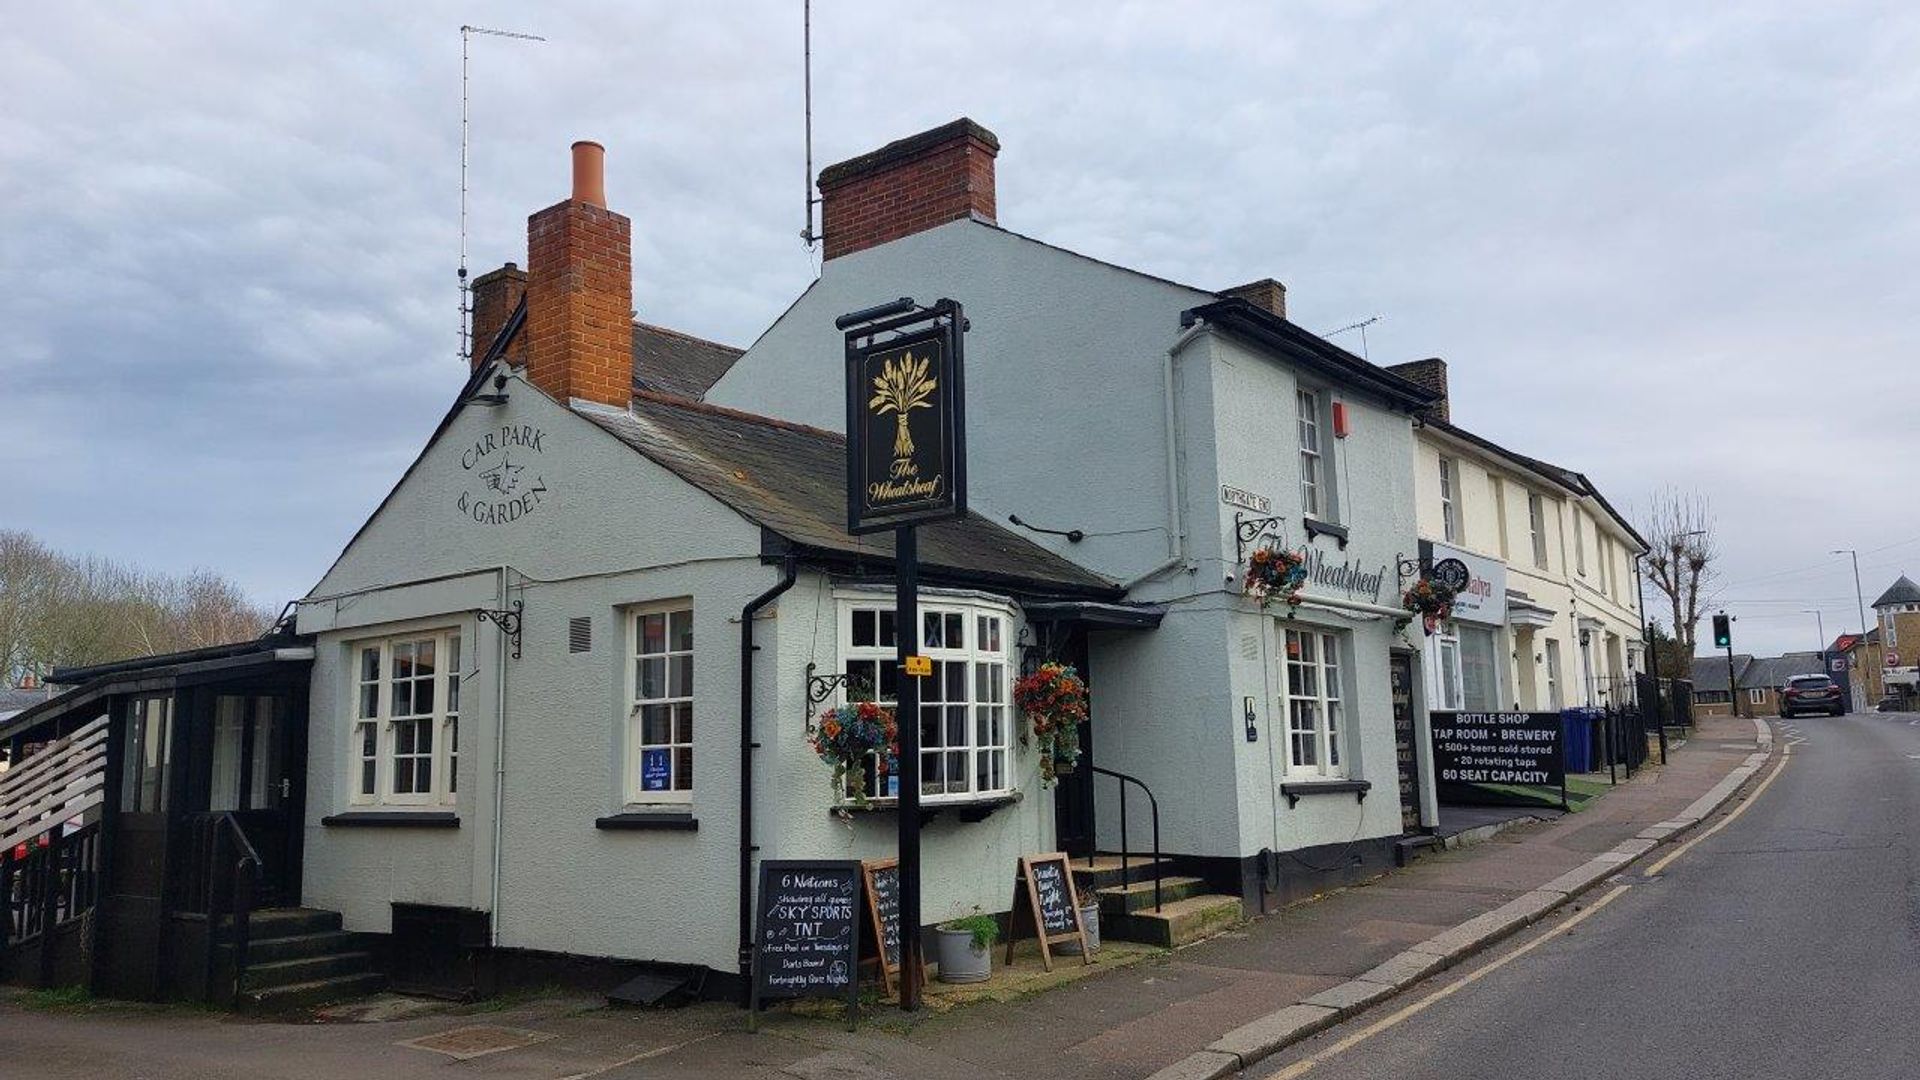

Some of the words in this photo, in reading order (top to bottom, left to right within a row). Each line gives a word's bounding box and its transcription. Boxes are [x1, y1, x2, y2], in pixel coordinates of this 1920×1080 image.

[462, 433, 497, 470] CAR
[502, 424, 546, 454] PARK
[889, 457, 919, 480] The
[868, 474, 942, 499] Wheatsheaf
[458, 491, 470, 515] &
[473, 476, 547, 525] GARDEN
[1300, 544, 1387, 605] Wheatsheaf
[1456, 713, 1496, 724] BOTTLE
[1498, 713, 1530, 724] SHOP
[1433, 729, 1454, 740] TAP
[1456, 729, 1488, 740] ROOM
[1501, 729, 1556, 741] BREWERY
[1445, 742, 1469, 753] 500+
[1470, 743, 1497, 753] beers
[1499, 744, 1518, 754] cold
[1520, 744, 1553, 754] stored
[1460, 755, 1473, 765] 20
[1474, 757, 1514, 768] rotating
[1515, 757, 1537, 769] taps
[1442, 769, 1458, 780] 60
[1459, 769, 1489, 781] SEAT
[1490, 770, 1549, 783] CAPACITY
[781, 874, 791, 888] 6
[793, 873, 839, 888] Nations
[779, 905, 809, 919] SKY
[811, 905, 852, 920] SPORTS
[793, 922, 824, 936] TNT
